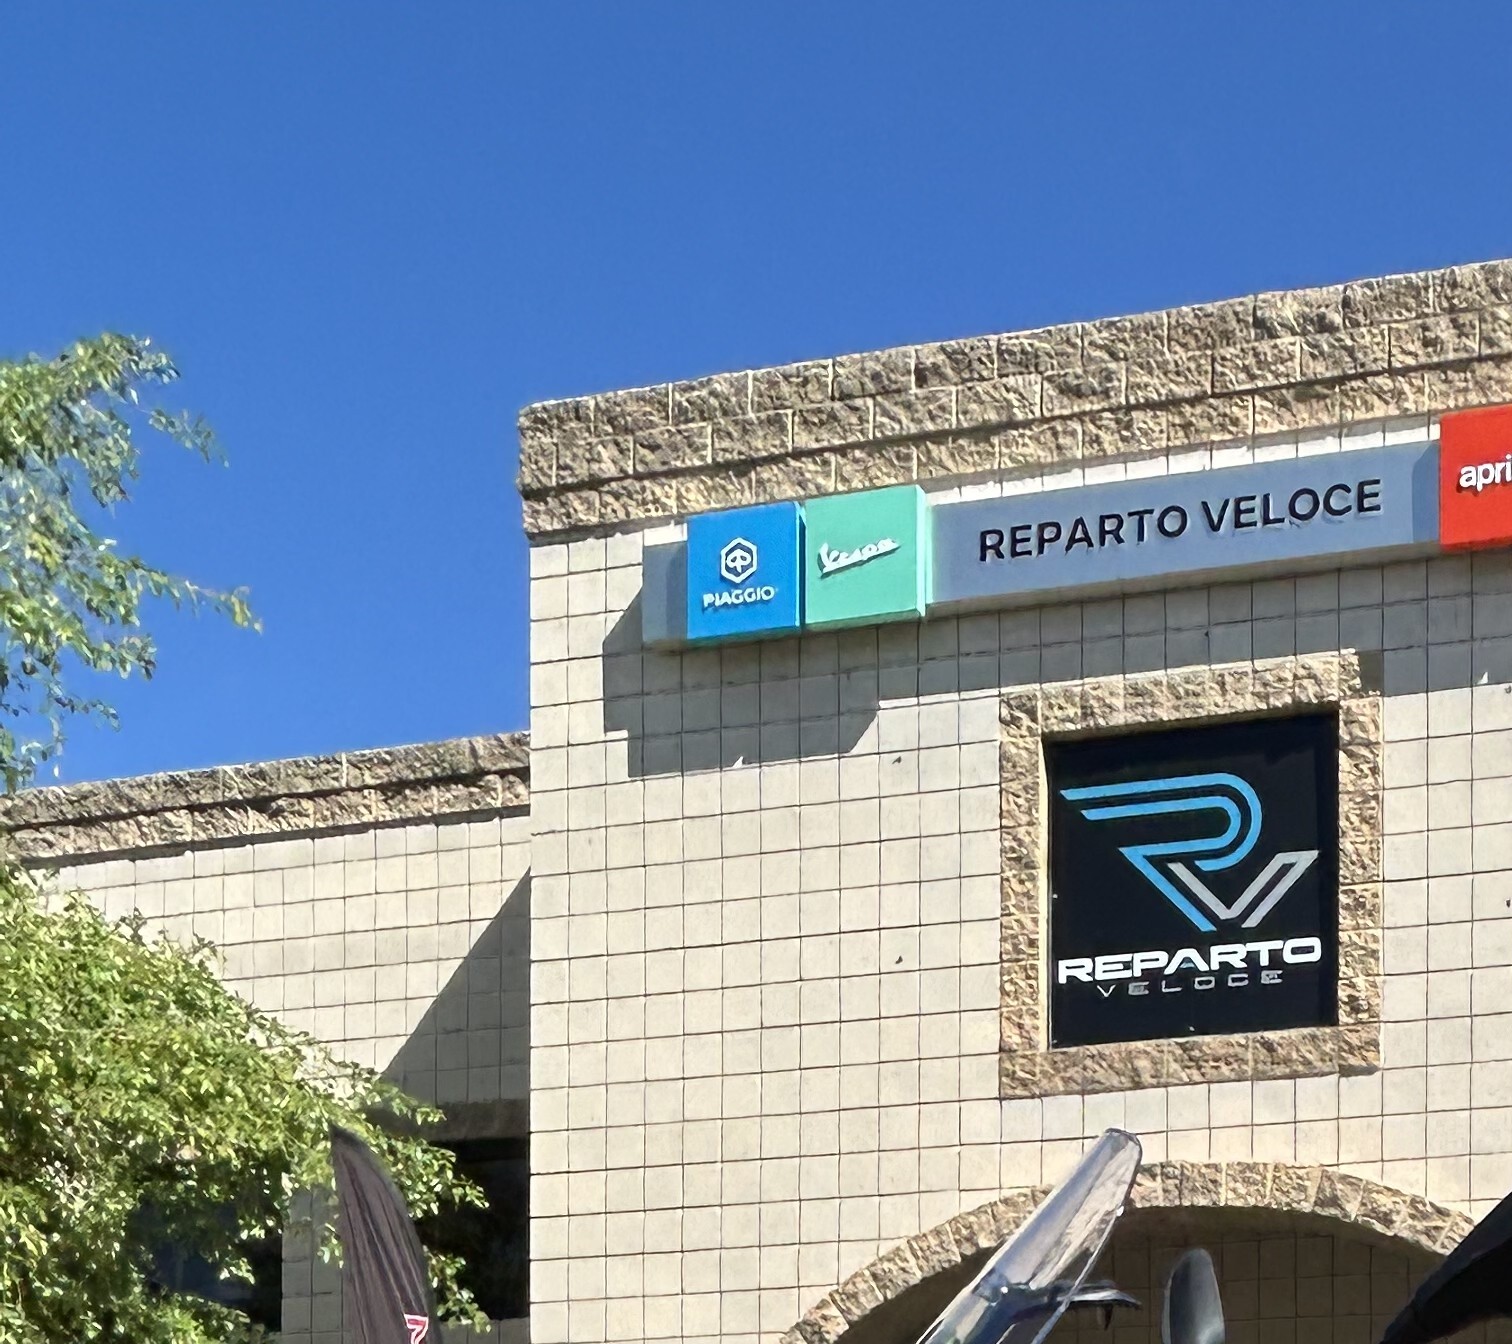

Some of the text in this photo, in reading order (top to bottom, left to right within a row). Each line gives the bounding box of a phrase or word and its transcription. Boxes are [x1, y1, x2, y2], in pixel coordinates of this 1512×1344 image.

[979, 477, 1383, 563] REPARTO VELOCE
[816, 536, 902, 579] Vespa
[702, 585, 776, 608] PIAGGIO
[1058, 936, 1322, 984] REPARTO
[1097, 969, 1284, 998] VELOCE
